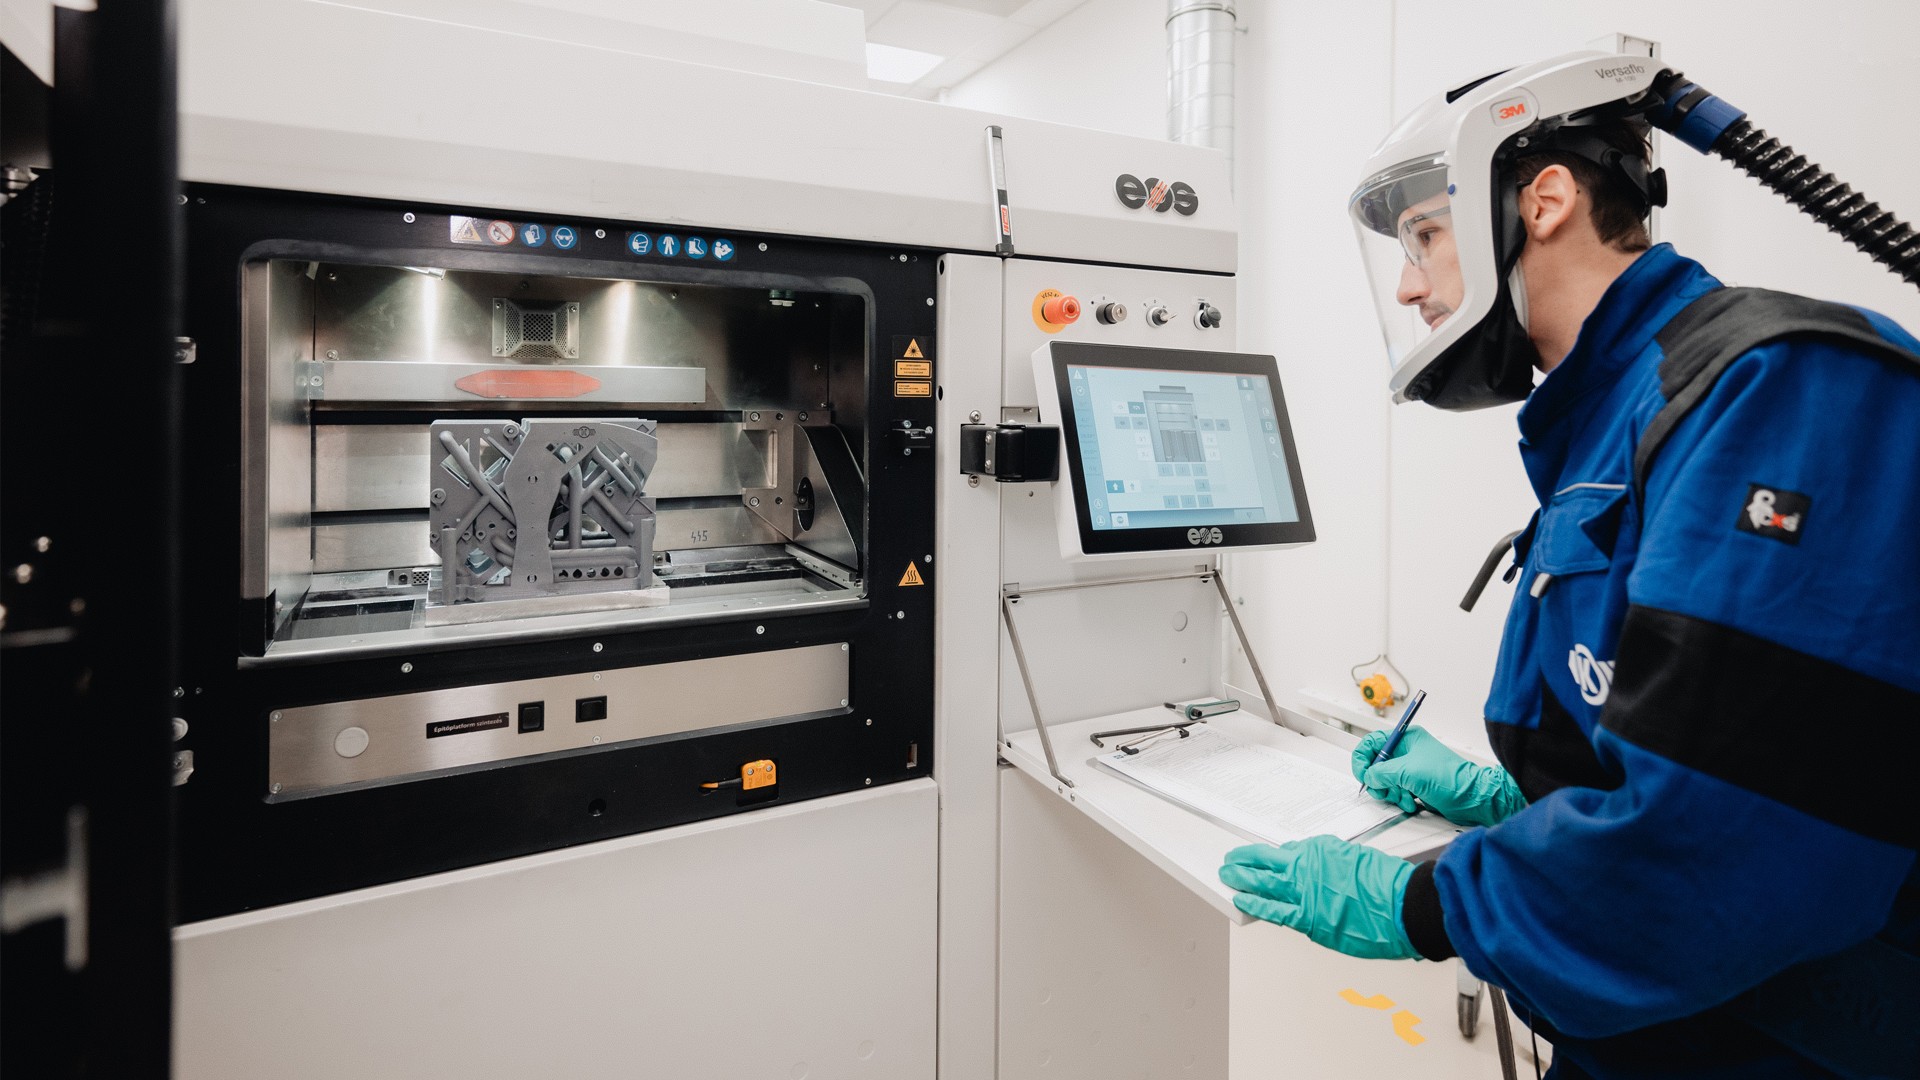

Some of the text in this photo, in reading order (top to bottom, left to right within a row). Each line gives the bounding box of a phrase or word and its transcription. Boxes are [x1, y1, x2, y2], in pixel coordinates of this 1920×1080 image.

[1594, 63, 1645, 79] Versaflo
[1499, 102, 1525, 119] 3M
[1114, 173, 1199, 217] eos
[1187, 527, 1223, 545] eos
